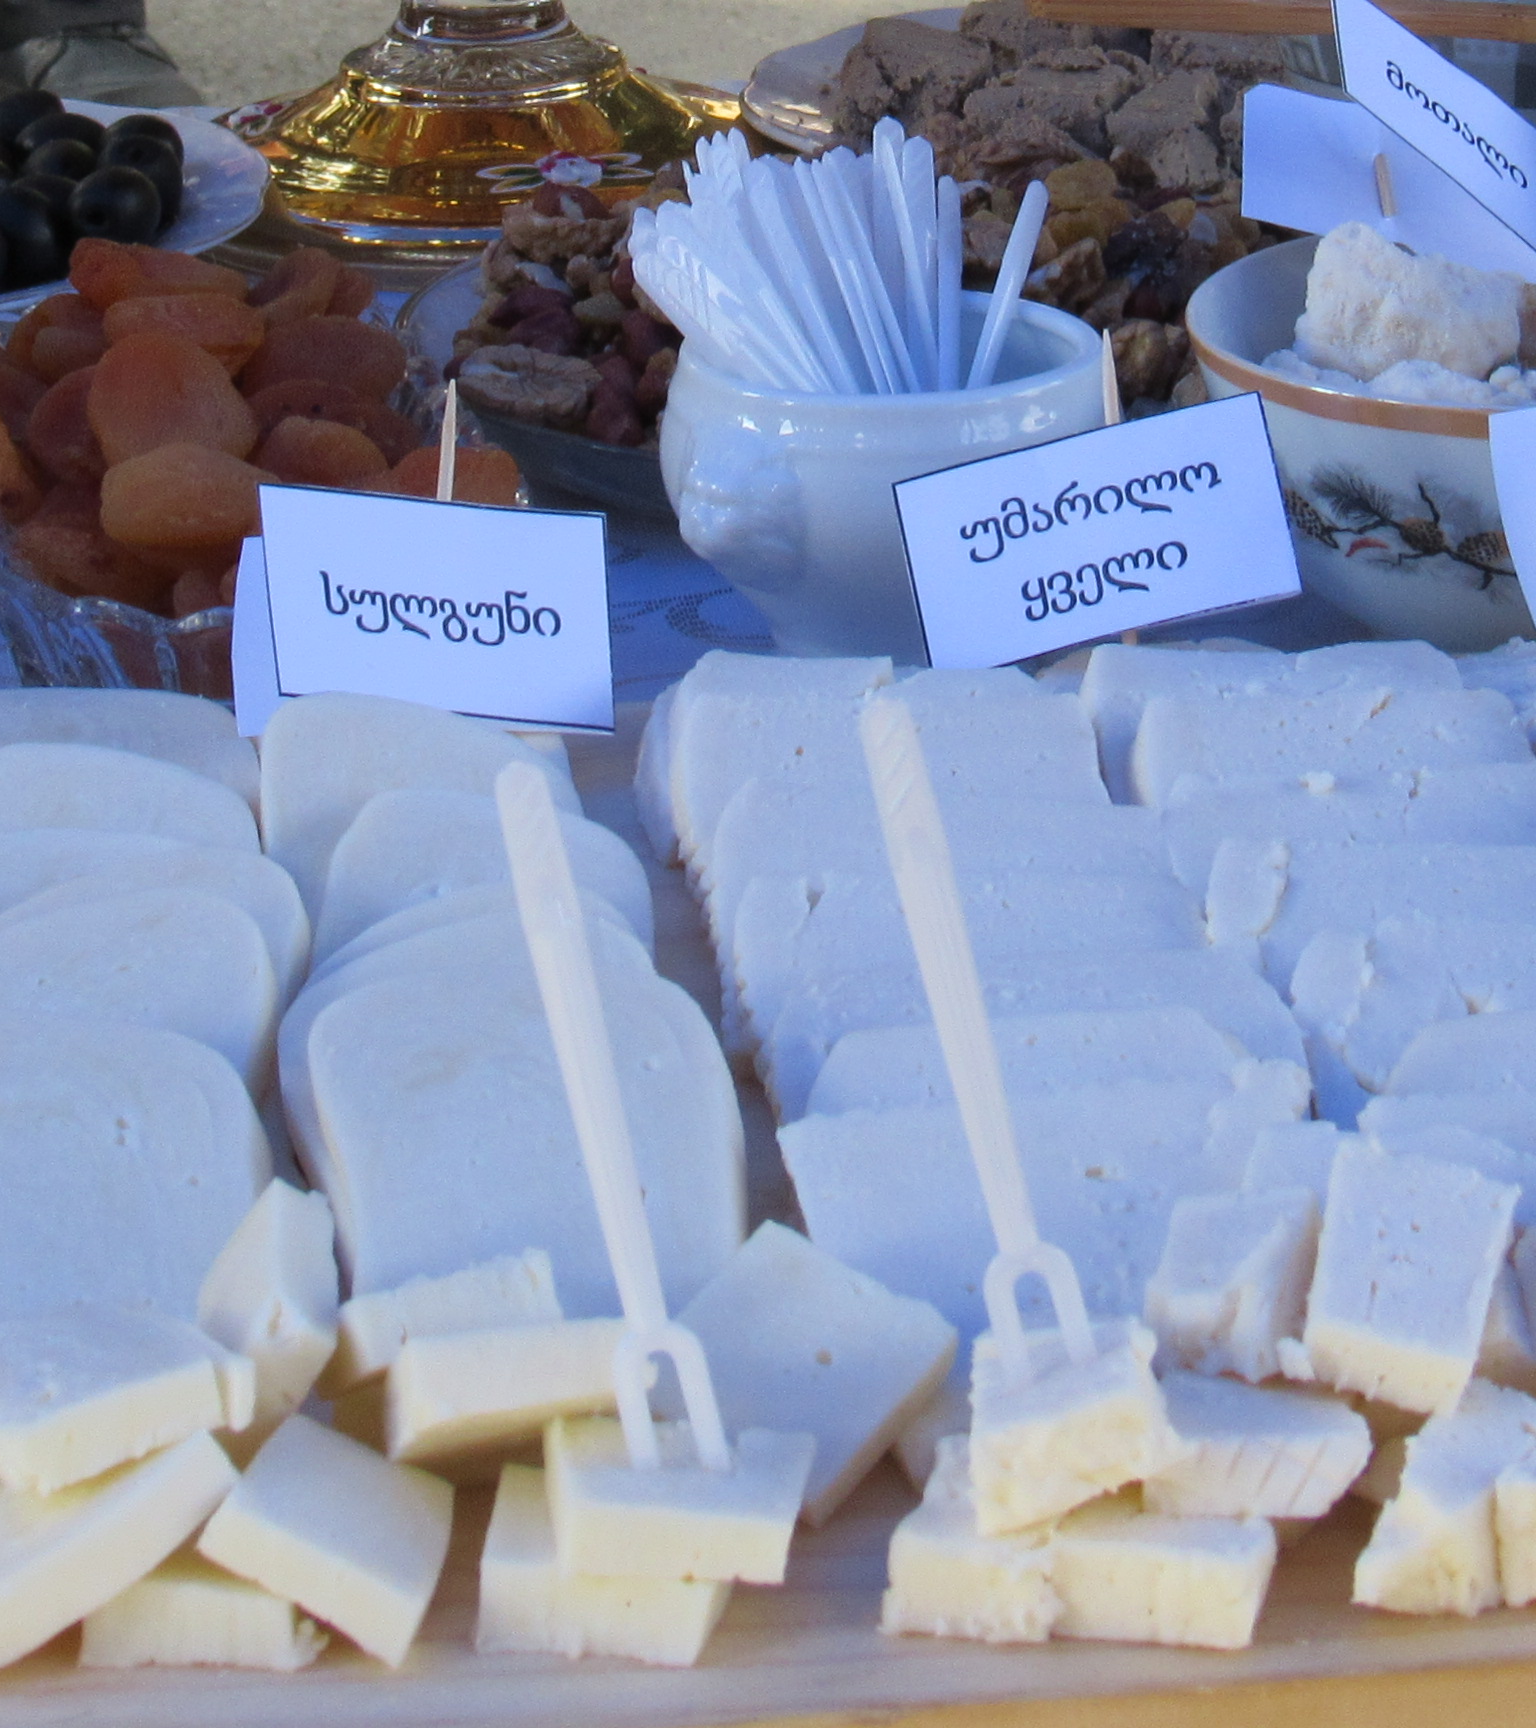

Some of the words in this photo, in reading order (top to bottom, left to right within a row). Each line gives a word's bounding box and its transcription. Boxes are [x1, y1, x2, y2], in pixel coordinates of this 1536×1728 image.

[1385, 59, 1529, 190] მოთალი
[958, 460, 1223, 564] უმარილო
[319, 569, 562, 647] სულგუნი
[1020, 539, 1189, 622] ყველი
